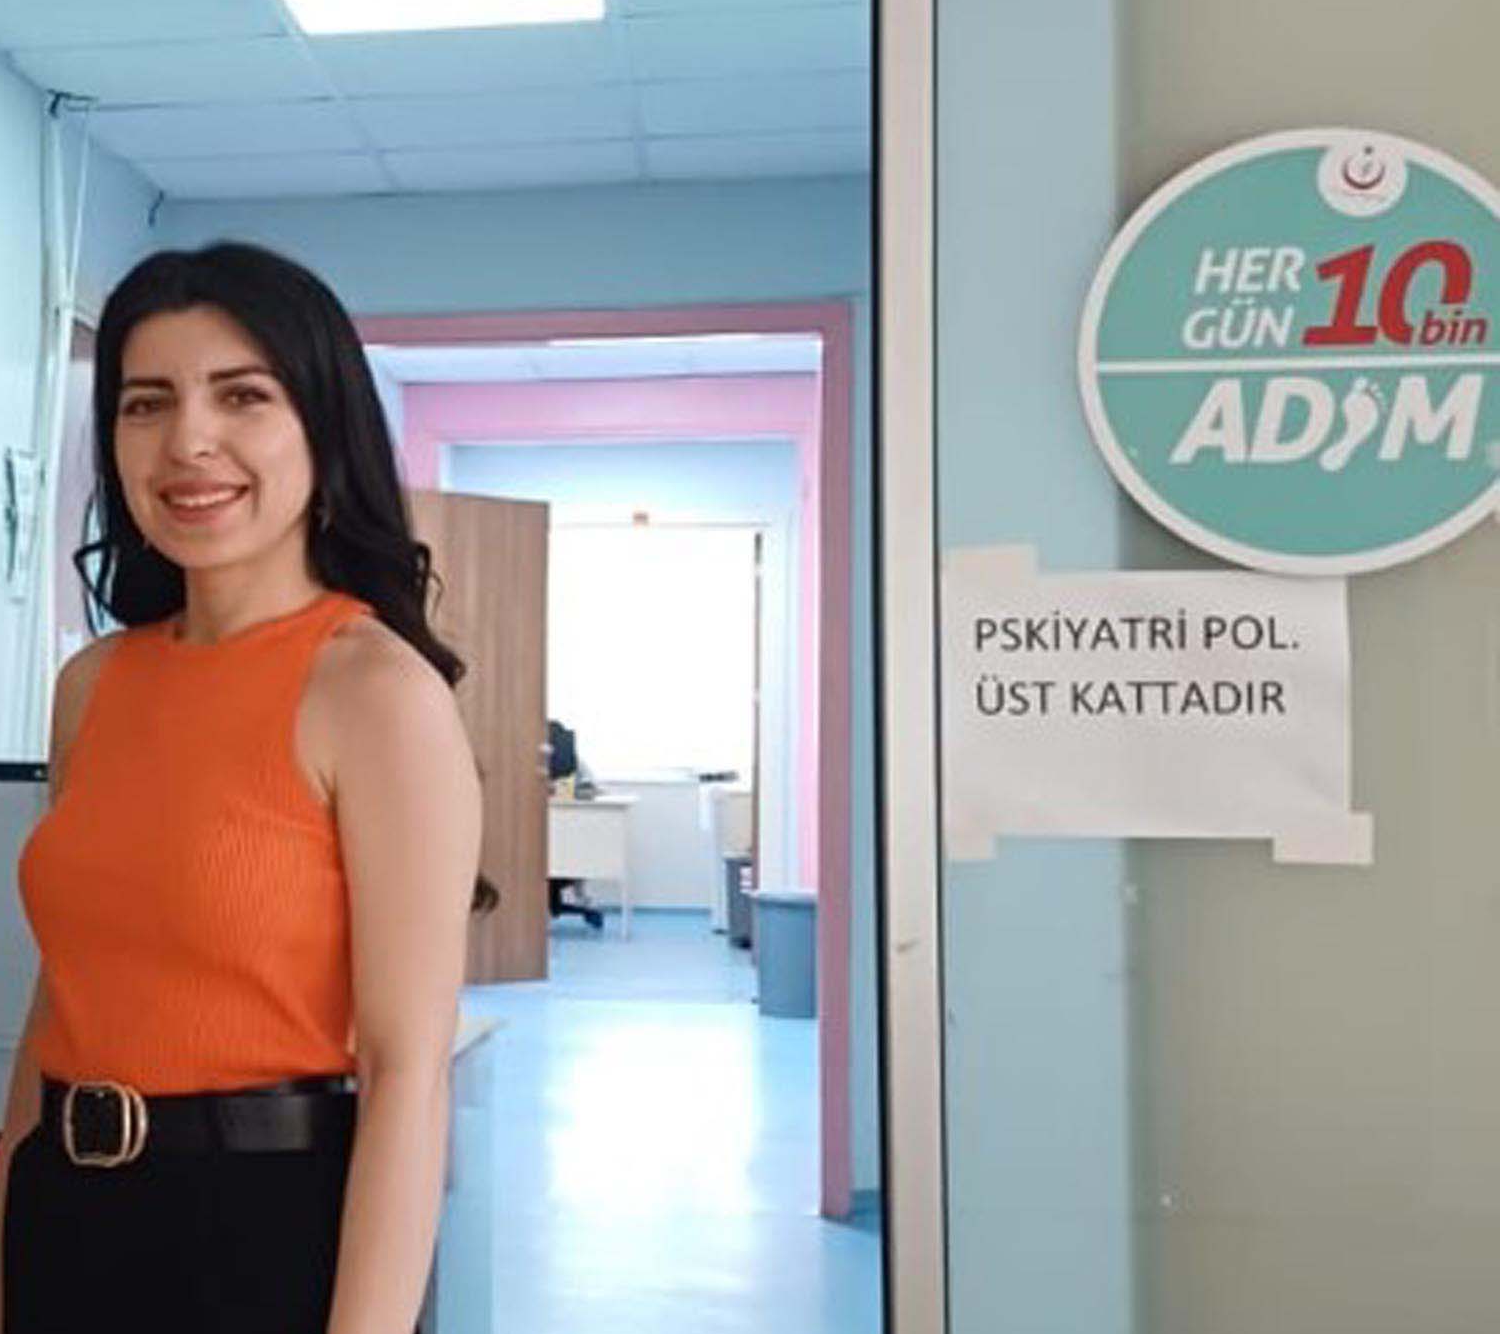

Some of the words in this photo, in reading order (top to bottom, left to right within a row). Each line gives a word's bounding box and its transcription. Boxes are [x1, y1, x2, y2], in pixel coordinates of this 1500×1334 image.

[1195, 245, 1305, 295] HER
[1302, 239, 1472, 346] 10
[1417, 310, 1488, 346] bin
[1182, 296, 1294, 350] GÜN
[974, 609, 1189, 653] PSKİYATRİ
[1202, 613, 1300, 652] POL.
[975, 673, 1057, 717] ÜST
[1070, 679, 1288, 716] KATTADIR
